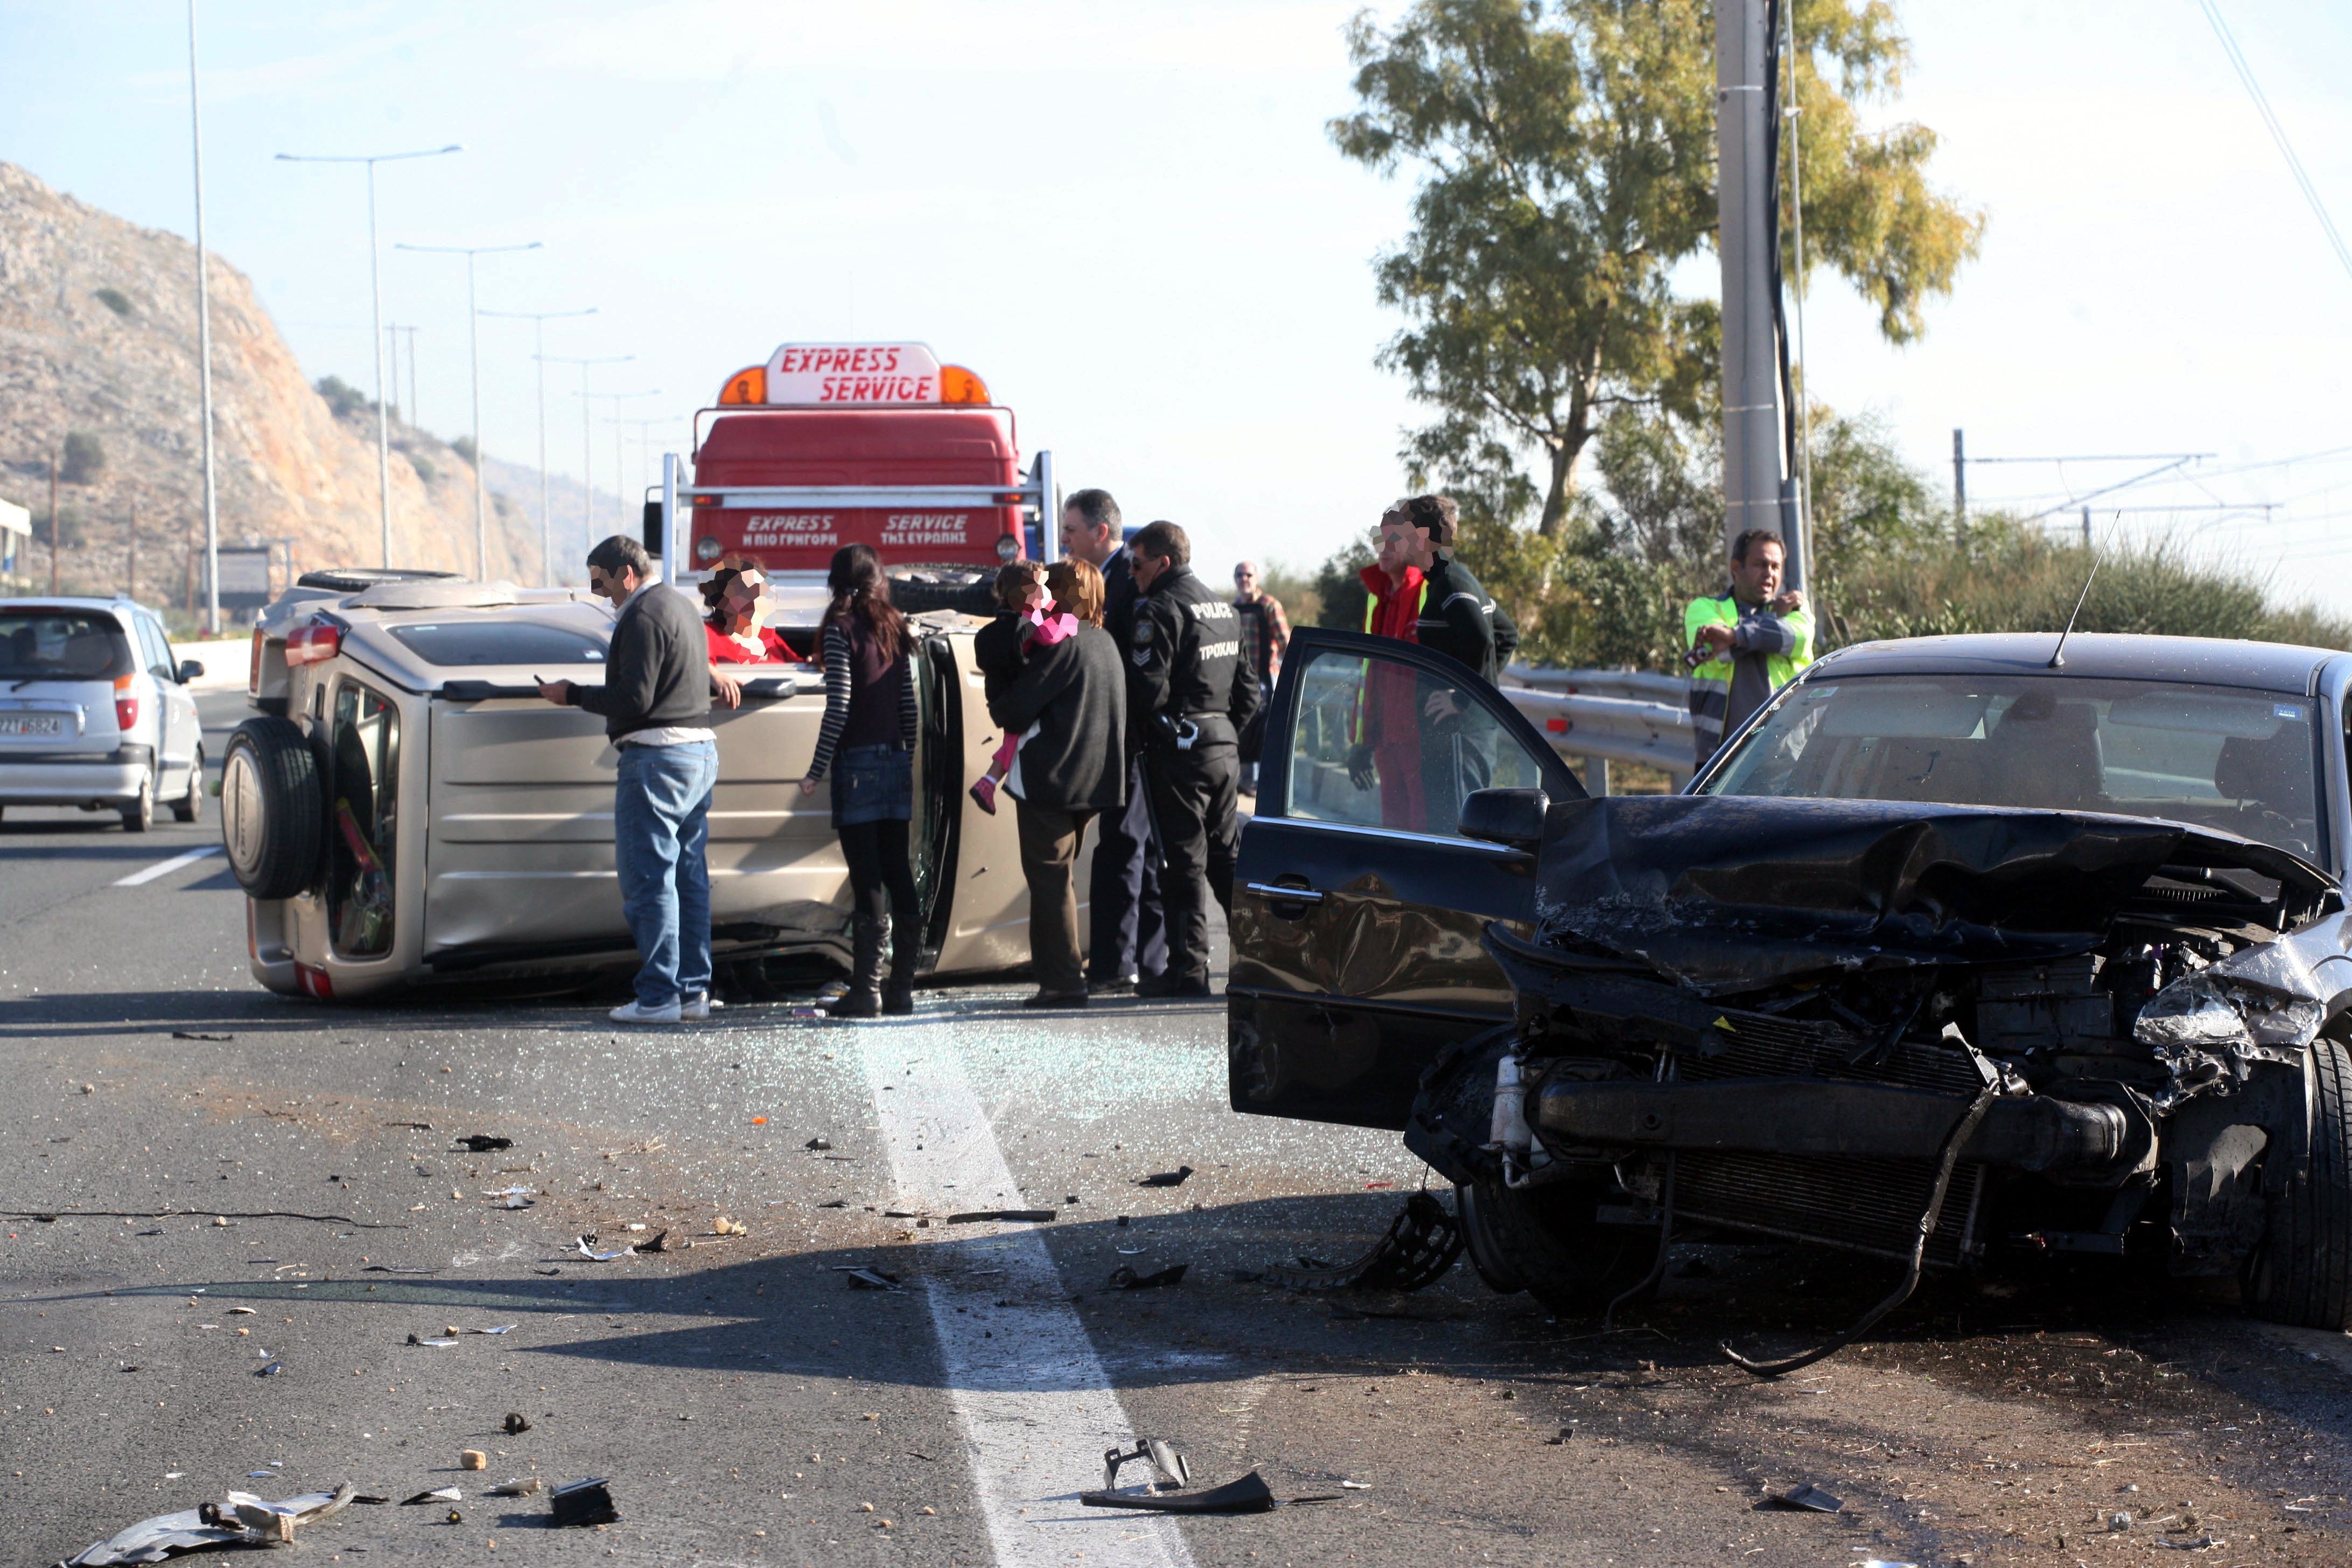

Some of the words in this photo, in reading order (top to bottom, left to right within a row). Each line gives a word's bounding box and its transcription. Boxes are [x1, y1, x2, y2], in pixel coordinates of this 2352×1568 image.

[781, 348, 901, 372] EXPRESS
[820, 377, 933, 401] SERVICE
[747, 515, 835, 531] EXPRESS
[886, 515, 968, 530] SERVICE
[754, 534, 778, 545] ΠΙΟ
[780, 534, 837, 545] ΓΡΗΓΟΡΗ
[1191, 602, 1233, 619] POLICE
